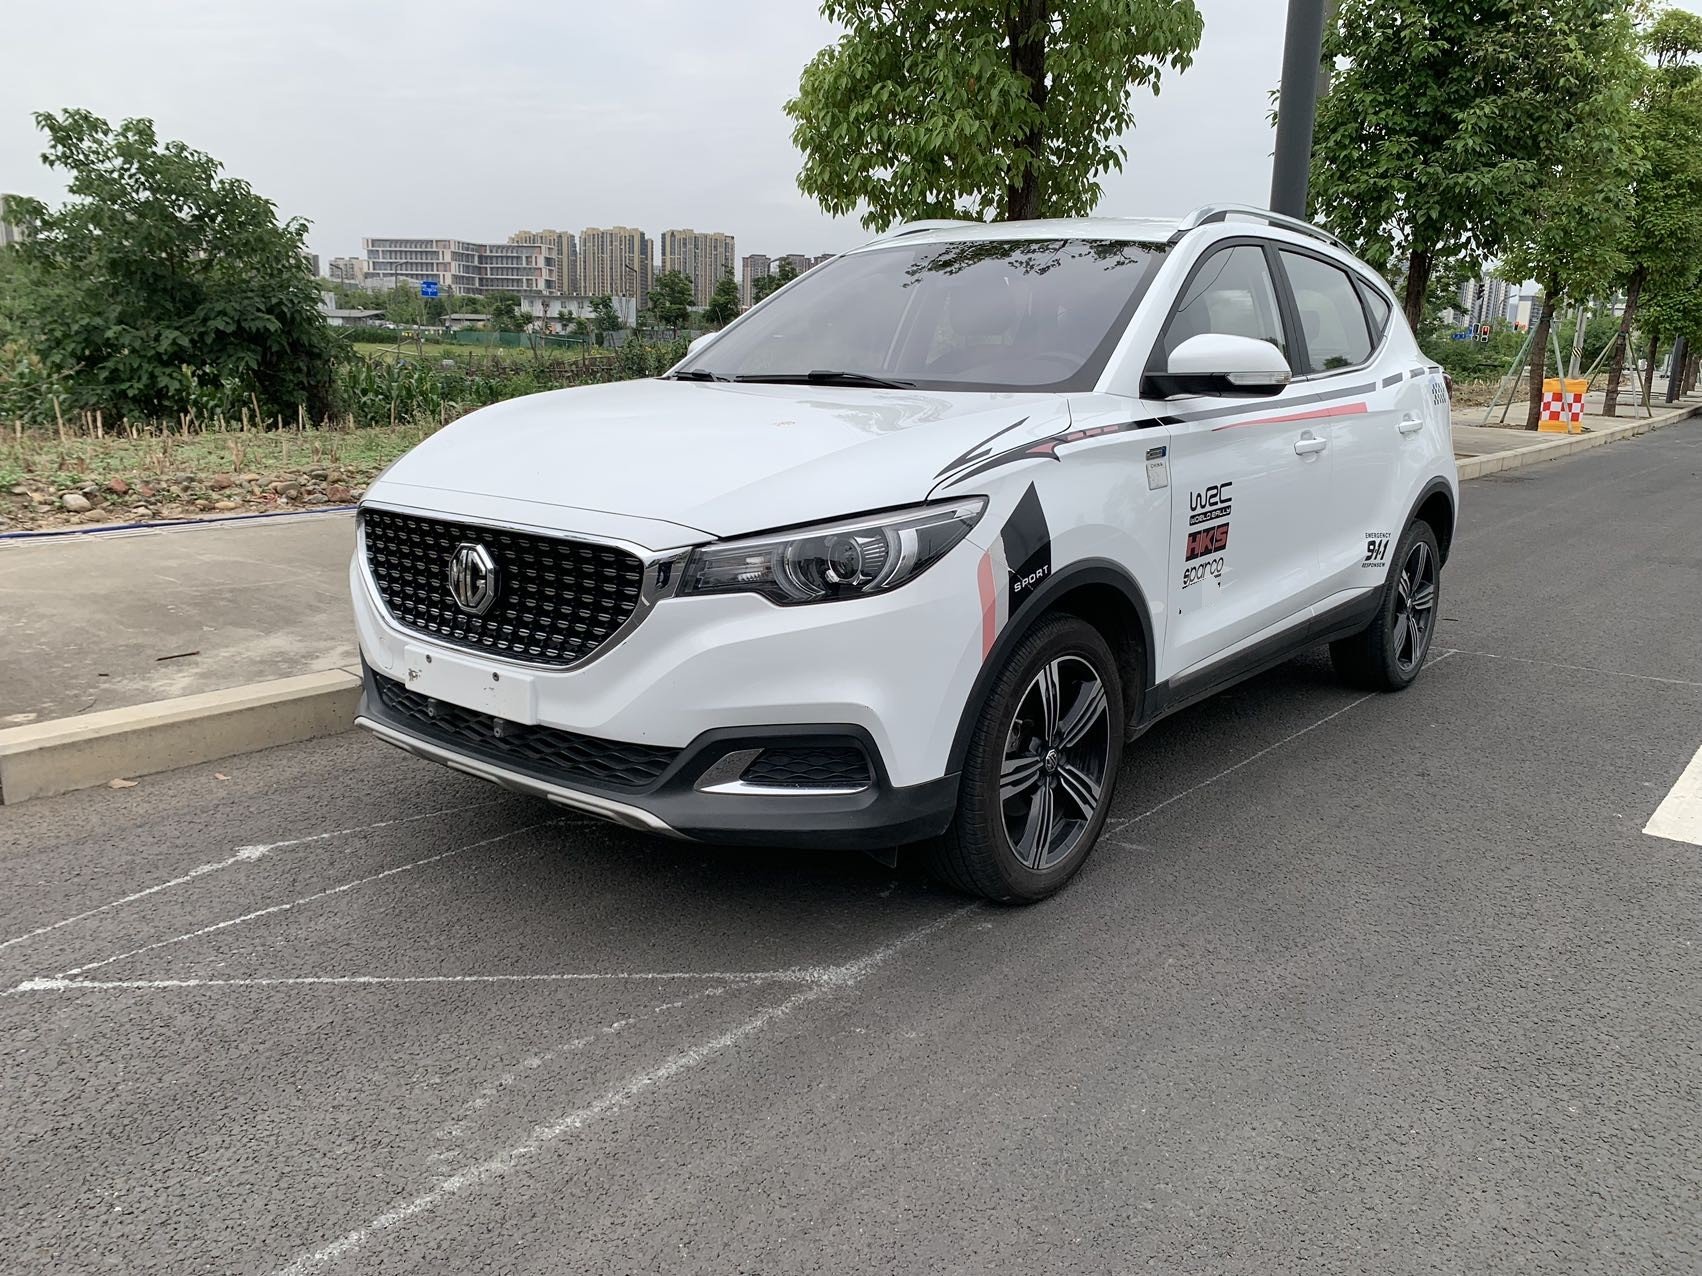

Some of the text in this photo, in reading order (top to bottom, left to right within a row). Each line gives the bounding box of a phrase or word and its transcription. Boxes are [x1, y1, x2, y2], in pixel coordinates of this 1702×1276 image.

[1190, 481, 1233, 511] WRC
[1190, 512, 1211, 524] WORLD
[1186, 525, 1229, 559] HKS
[449, 547, 487, 609] MG
[1014, 565, 1049, 592] SPORT
[1183, 557, 1224, 586] sparco
